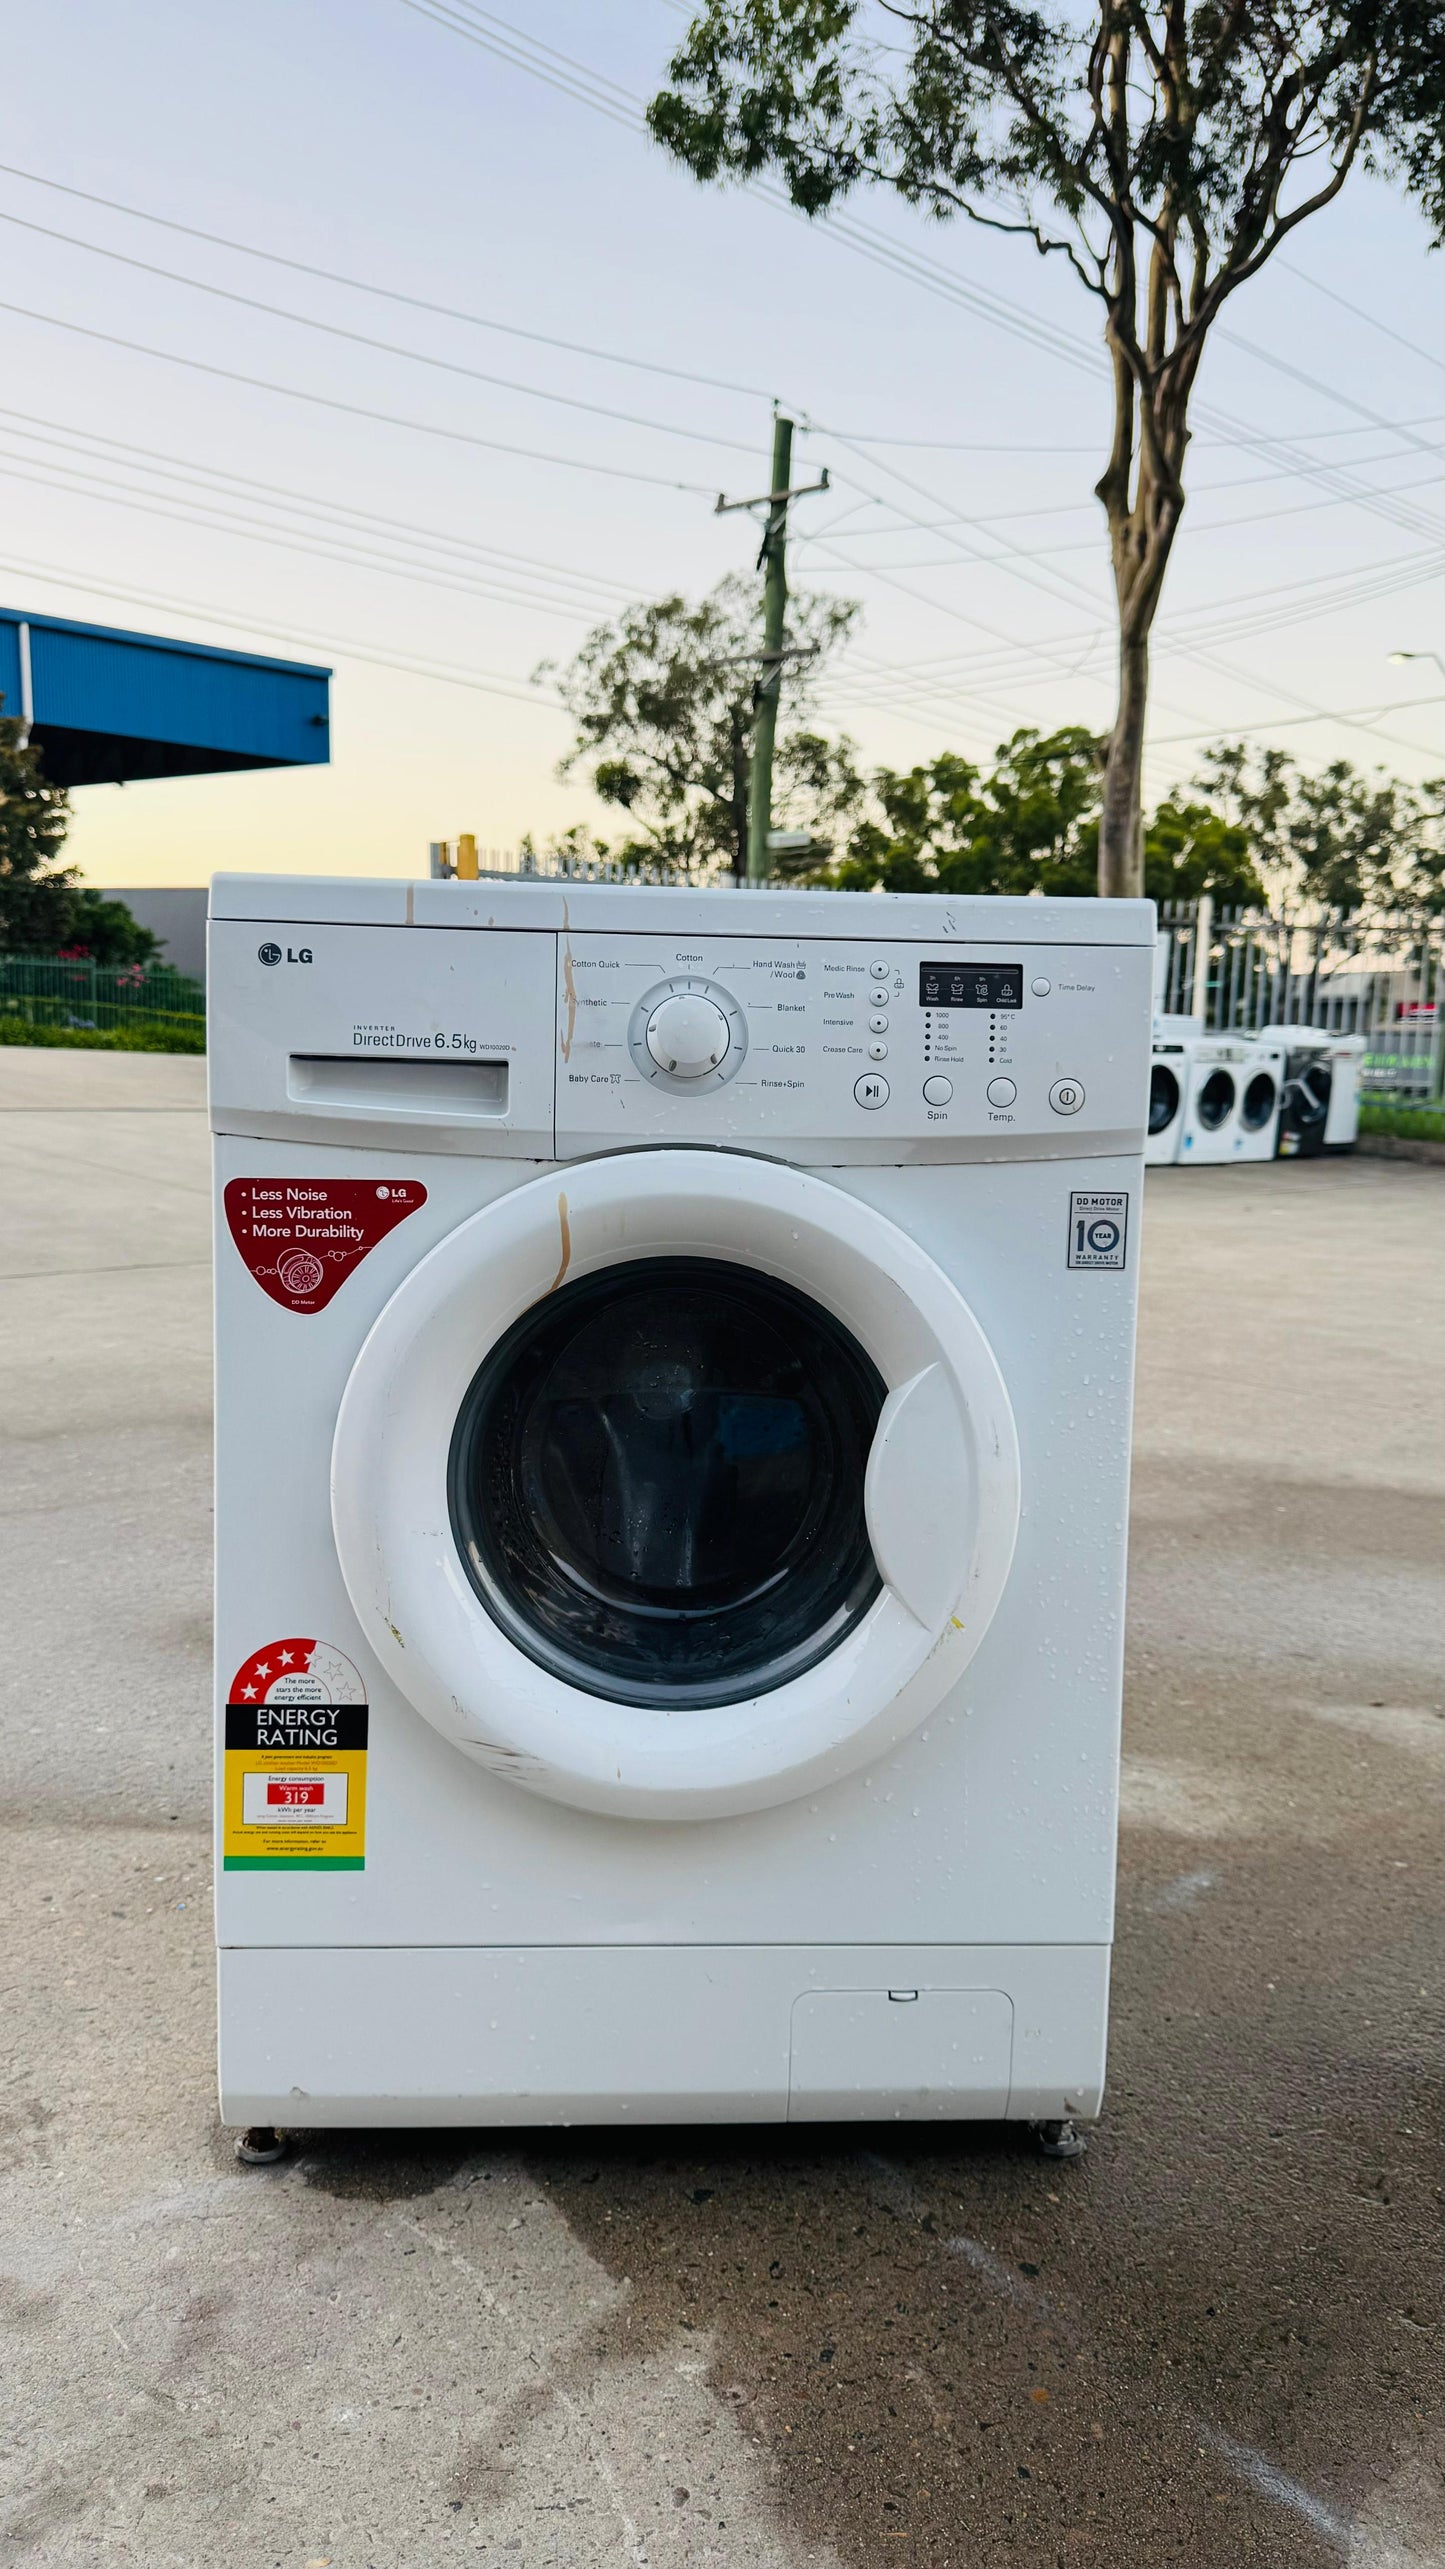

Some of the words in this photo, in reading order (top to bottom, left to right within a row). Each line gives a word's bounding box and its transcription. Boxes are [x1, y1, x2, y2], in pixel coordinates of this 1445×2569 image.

[287, 948, 313, 964] LG
[676, 953, 703, 962] Cotton
[571, 960, 596, 968] Cotton
[598, 960, 620, 969] Quick
[752, 960, 772, 968] Hand
[774, 960, 796, 969] Wash
[824, 964, 845, 972] Medic
[1076, 984, 1095, 993] Delay
[573, 998, 608, 1007] ynthetic
[776, 1004, 805, 1012] Blanket
[823, 1018, 854, 1026] Intensive
[772, 1045, 794, 1054] Quick
[847, 1046, 863, 1054] Care
[568, 1074, 590, 1084] Baby
[591, 1074, 609, 1082] Care
[761, 1080, 804, 1089] Rinse+Spin
[926, 1110, 948, 1121] Spin
[988, 1112, 1015, 1122] Temp.
[252, 1187, 283, 1201] Less
[286, 1188, 328, 1201] Noise
[391, 1189, 406, 1198] LG
[1076, 1197, 1089, 1205] DD
[1091, 1198, 1123, 1206] MOTOR
[252, 1206, 283, 1219] Less
[286, 1206, 352, 1220] Vibration
[252, 1224, 290, 1238] More
[295, 1224, 364, 1241] Durability
[1076, 1219, 1120, 1252] 10
[257, 1710, 340, 1726] ENERGY
[257, 1729, 338, 1746] RATING
[268, 1775, 287, 1783] Energy
[284, 1791, 309, 1804] 319
